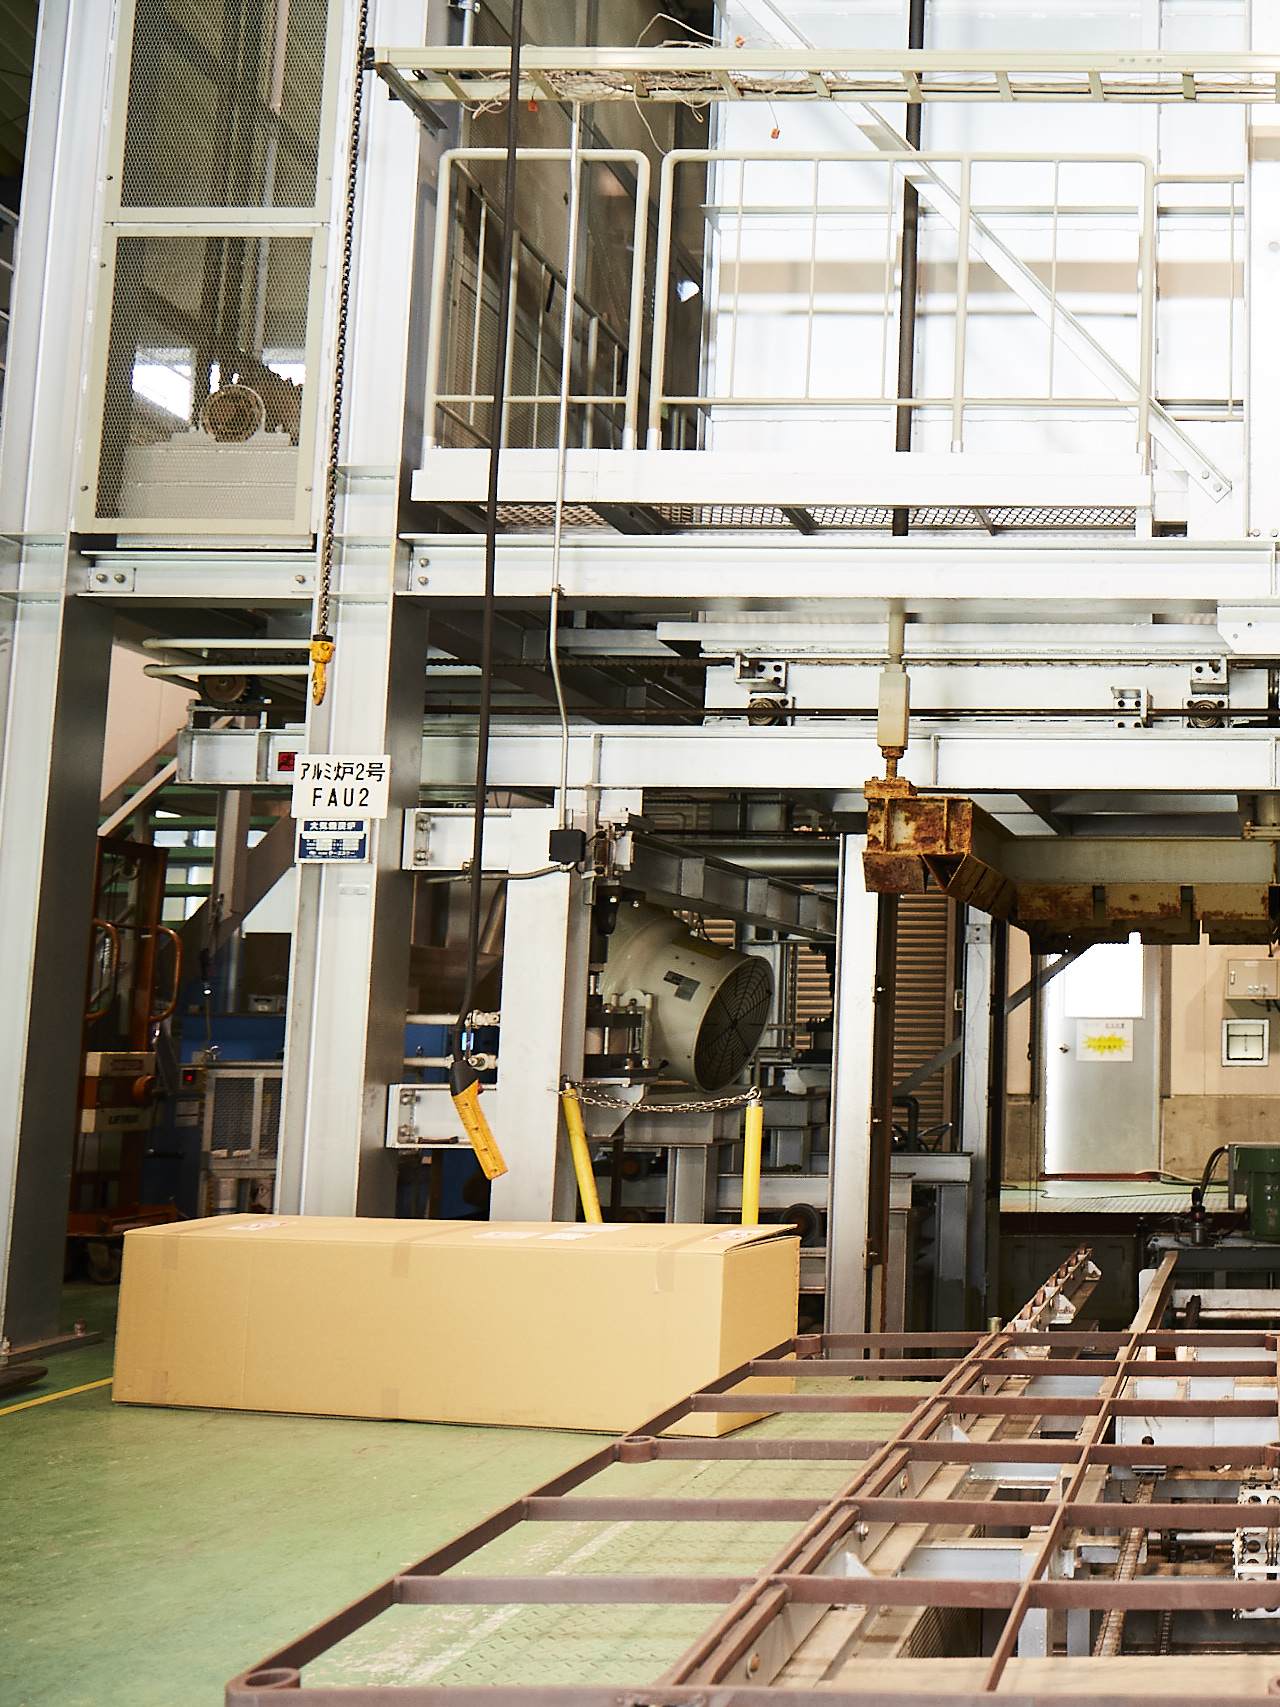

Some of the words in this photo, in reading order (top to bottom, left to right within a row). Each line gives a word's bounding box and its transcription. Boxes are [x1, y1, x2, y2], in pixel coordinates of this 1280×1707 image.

[300, 762, 386, 782] アルミ炉2号
[312, 787, 370, 807] FAU2
